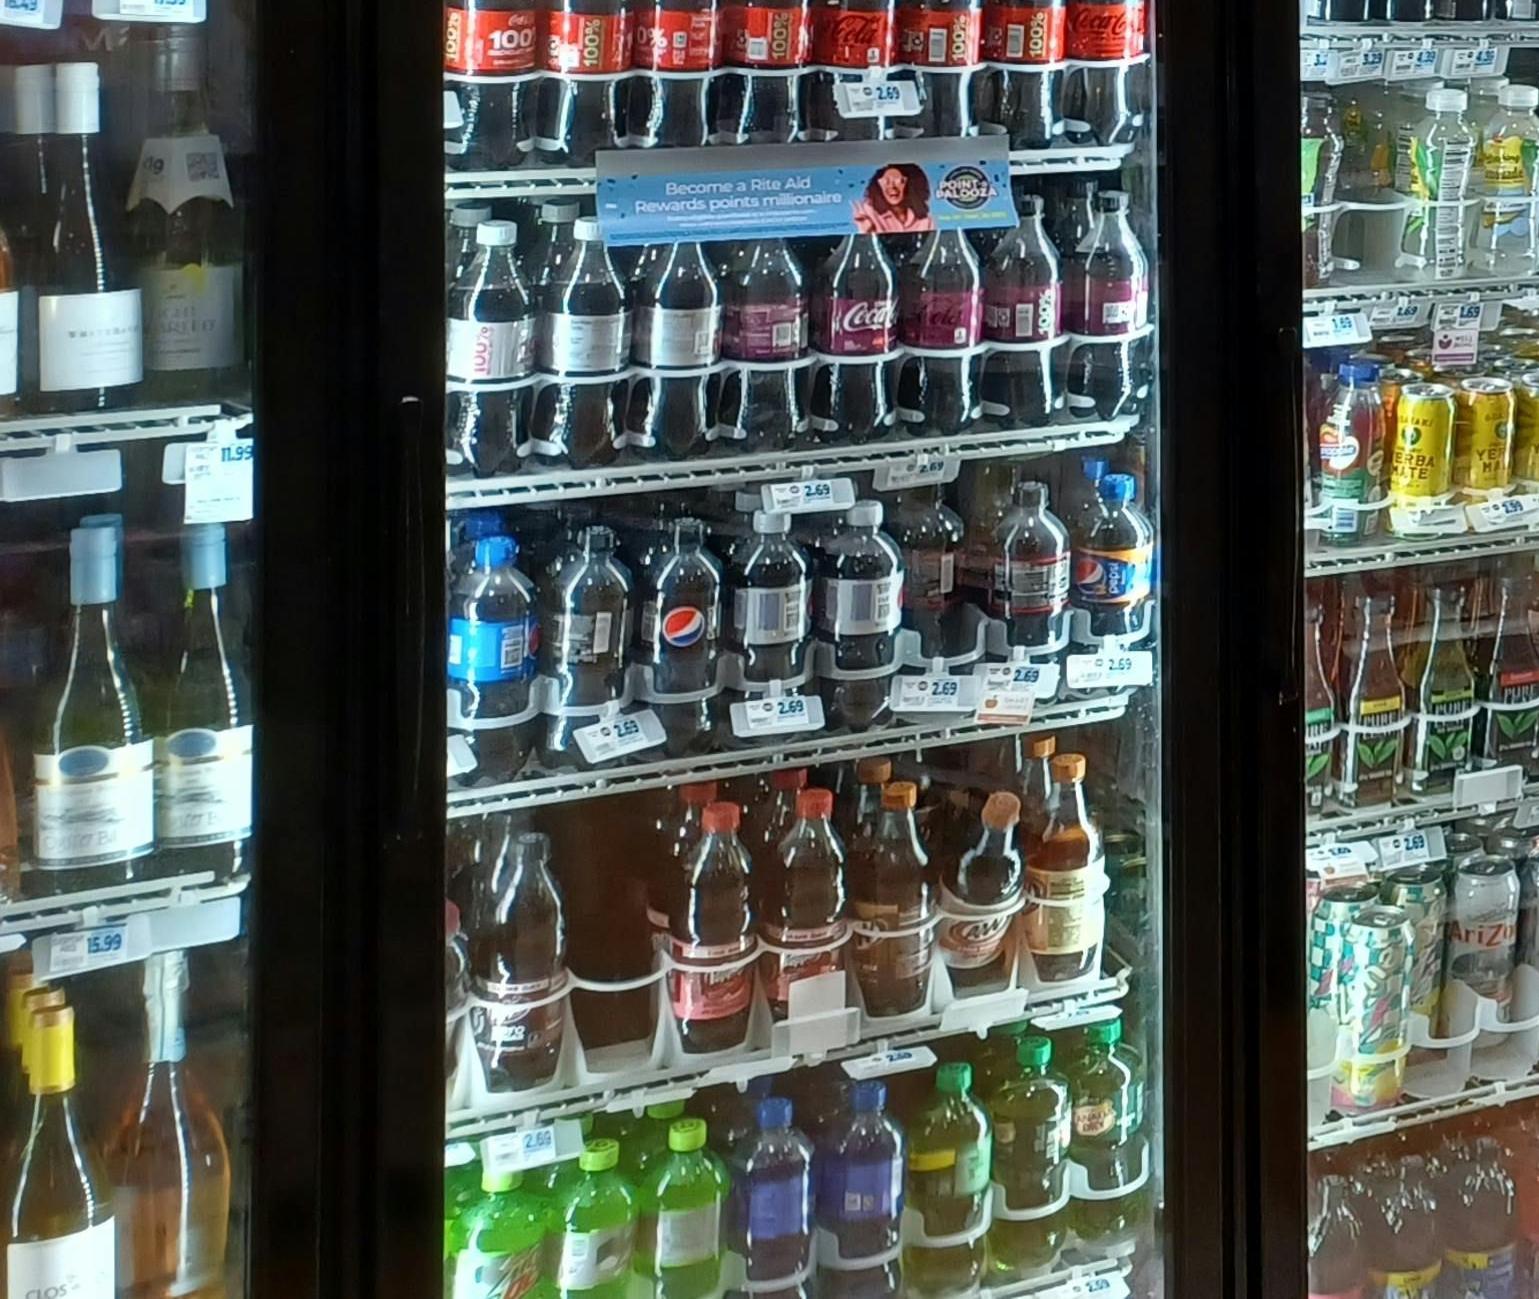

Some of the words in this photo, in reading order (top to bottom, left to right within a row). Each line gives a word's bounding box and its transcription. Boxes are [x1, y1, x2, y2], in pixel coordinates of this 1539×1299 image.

[582, 19, 603, 67] 100%
[772, 13, 789, 60] 100%
[951, 14, 968, 63] 100%
[1029, 13, 1046, 59] 100%
[876, 87, 900, 100] 2.69
[665, 181, 733, 196] Become
[736, 183, 746, 194] a
[751, 178, 781, 193] Rite
[784, 176, 811, 191] Aid
[635, 198, 706, 214] Rewards
[709, 196, 758, 213] points
[762, 191, 843, 207] millionaire
[473, 327, 495, 376] 100%
[221, 447, 253, 462] 11.99
[919, 461, 944, 473] 2.69
[804, 484, 830, 496] 2.69
[1108, 659, 1132, 671] 2.69
[1013, 669, 1039, 682] 2.69
[932, 682, 957, 695] 2.69
[778, 700, 804, 715] 2.69
[614, 720, 639, 737] 2.69
[87, 934, 123, 954] 15.99
